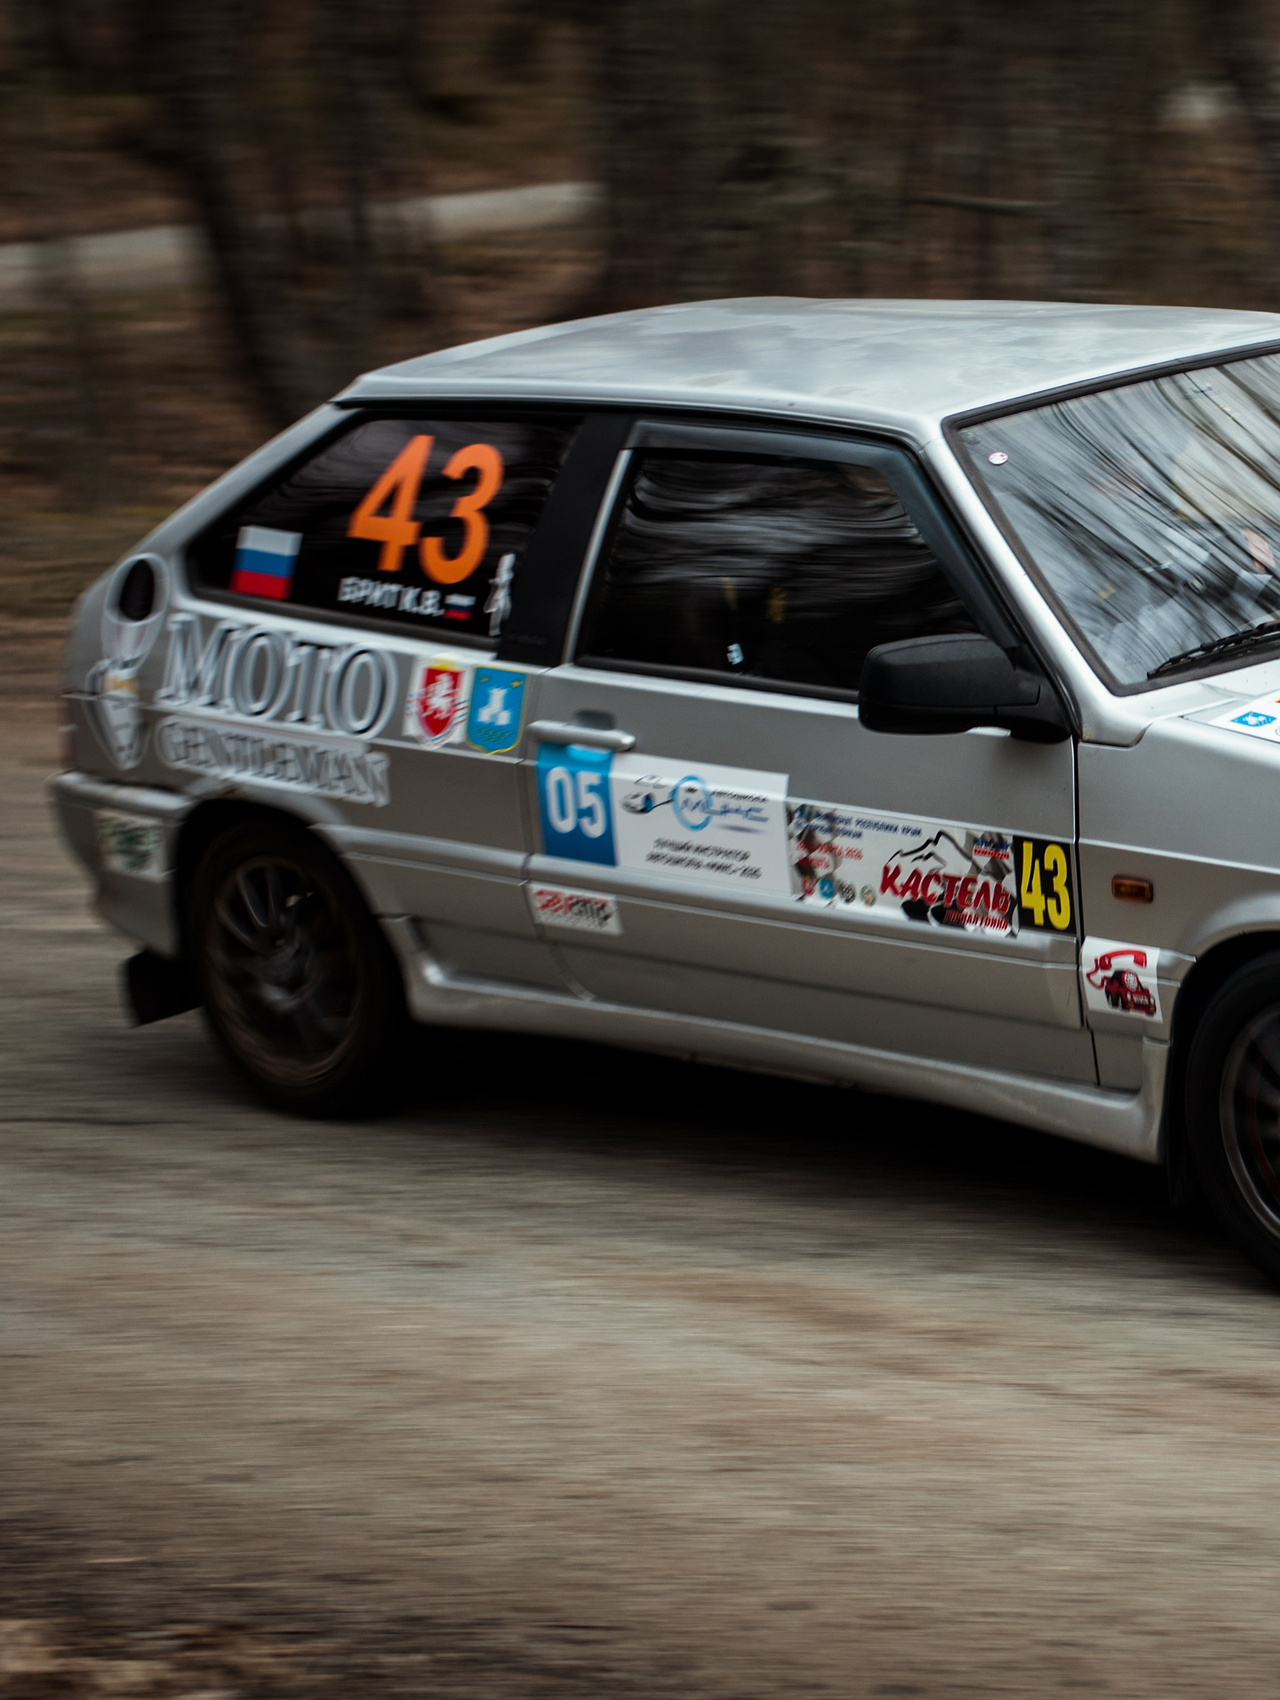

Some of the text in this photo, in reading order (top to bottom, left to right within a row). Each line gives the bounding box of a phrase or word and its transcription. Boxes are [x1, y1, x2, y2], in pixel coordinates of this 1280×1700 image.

[347, 434, 504, 585] 43
[155, 612, 399, 740] MOTO
[157, 714, 391, 807] GENTLEMAN
[546, 766, 608, 839] 05
[879, 863, 1012, 915] КАСТЕЛЬ
[1020, 840, 1071, 931] 43
